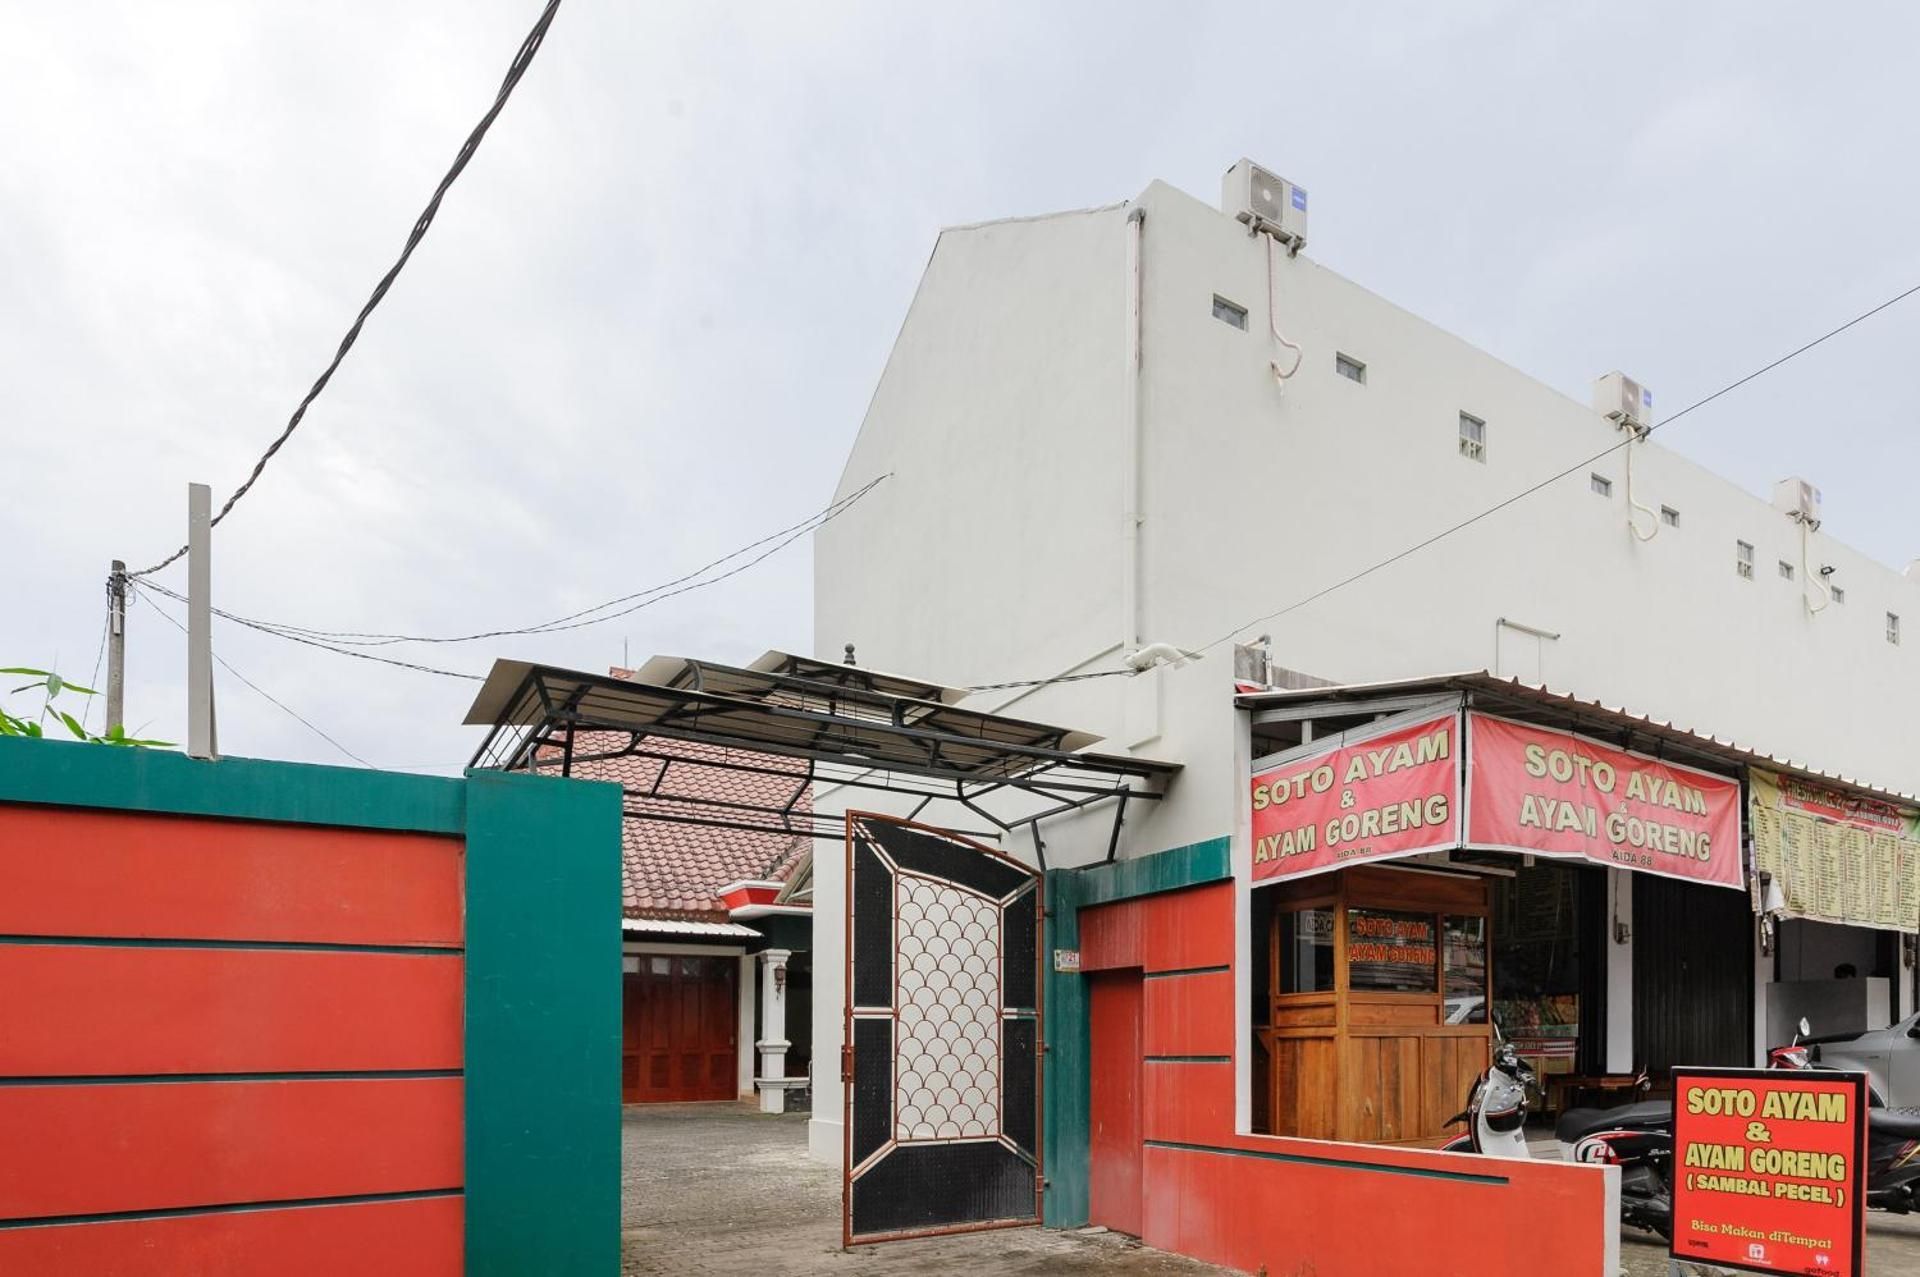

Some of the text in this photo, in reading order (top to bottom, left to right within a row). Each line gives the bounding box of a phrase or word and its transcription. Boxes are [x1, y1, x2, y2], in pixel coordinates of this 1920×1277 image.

[1252, 730, 1450, 811] SOTO AYAM
[1524, 743, 1708, 817] SOTO AYAM
[1340, 789, 1356, 809] &
[1254, 795, 1449, 864] AYAM GORENG
[1604, 812, 1711, 862] GORENG
[1612, 850, 1637, 864] AIDA
[1349, 943, 1386, 962] AYAM
[1686, 1086, 1847, 1123] SOTO AYAM
[1744, 1121, 1771, 1143] &
[1685, 1143, 1847, 1183] AYAM GORENG
[1691, 1219, 1718, 1233] Bisa
[1721, 1223, 1765, 1240] Makan
